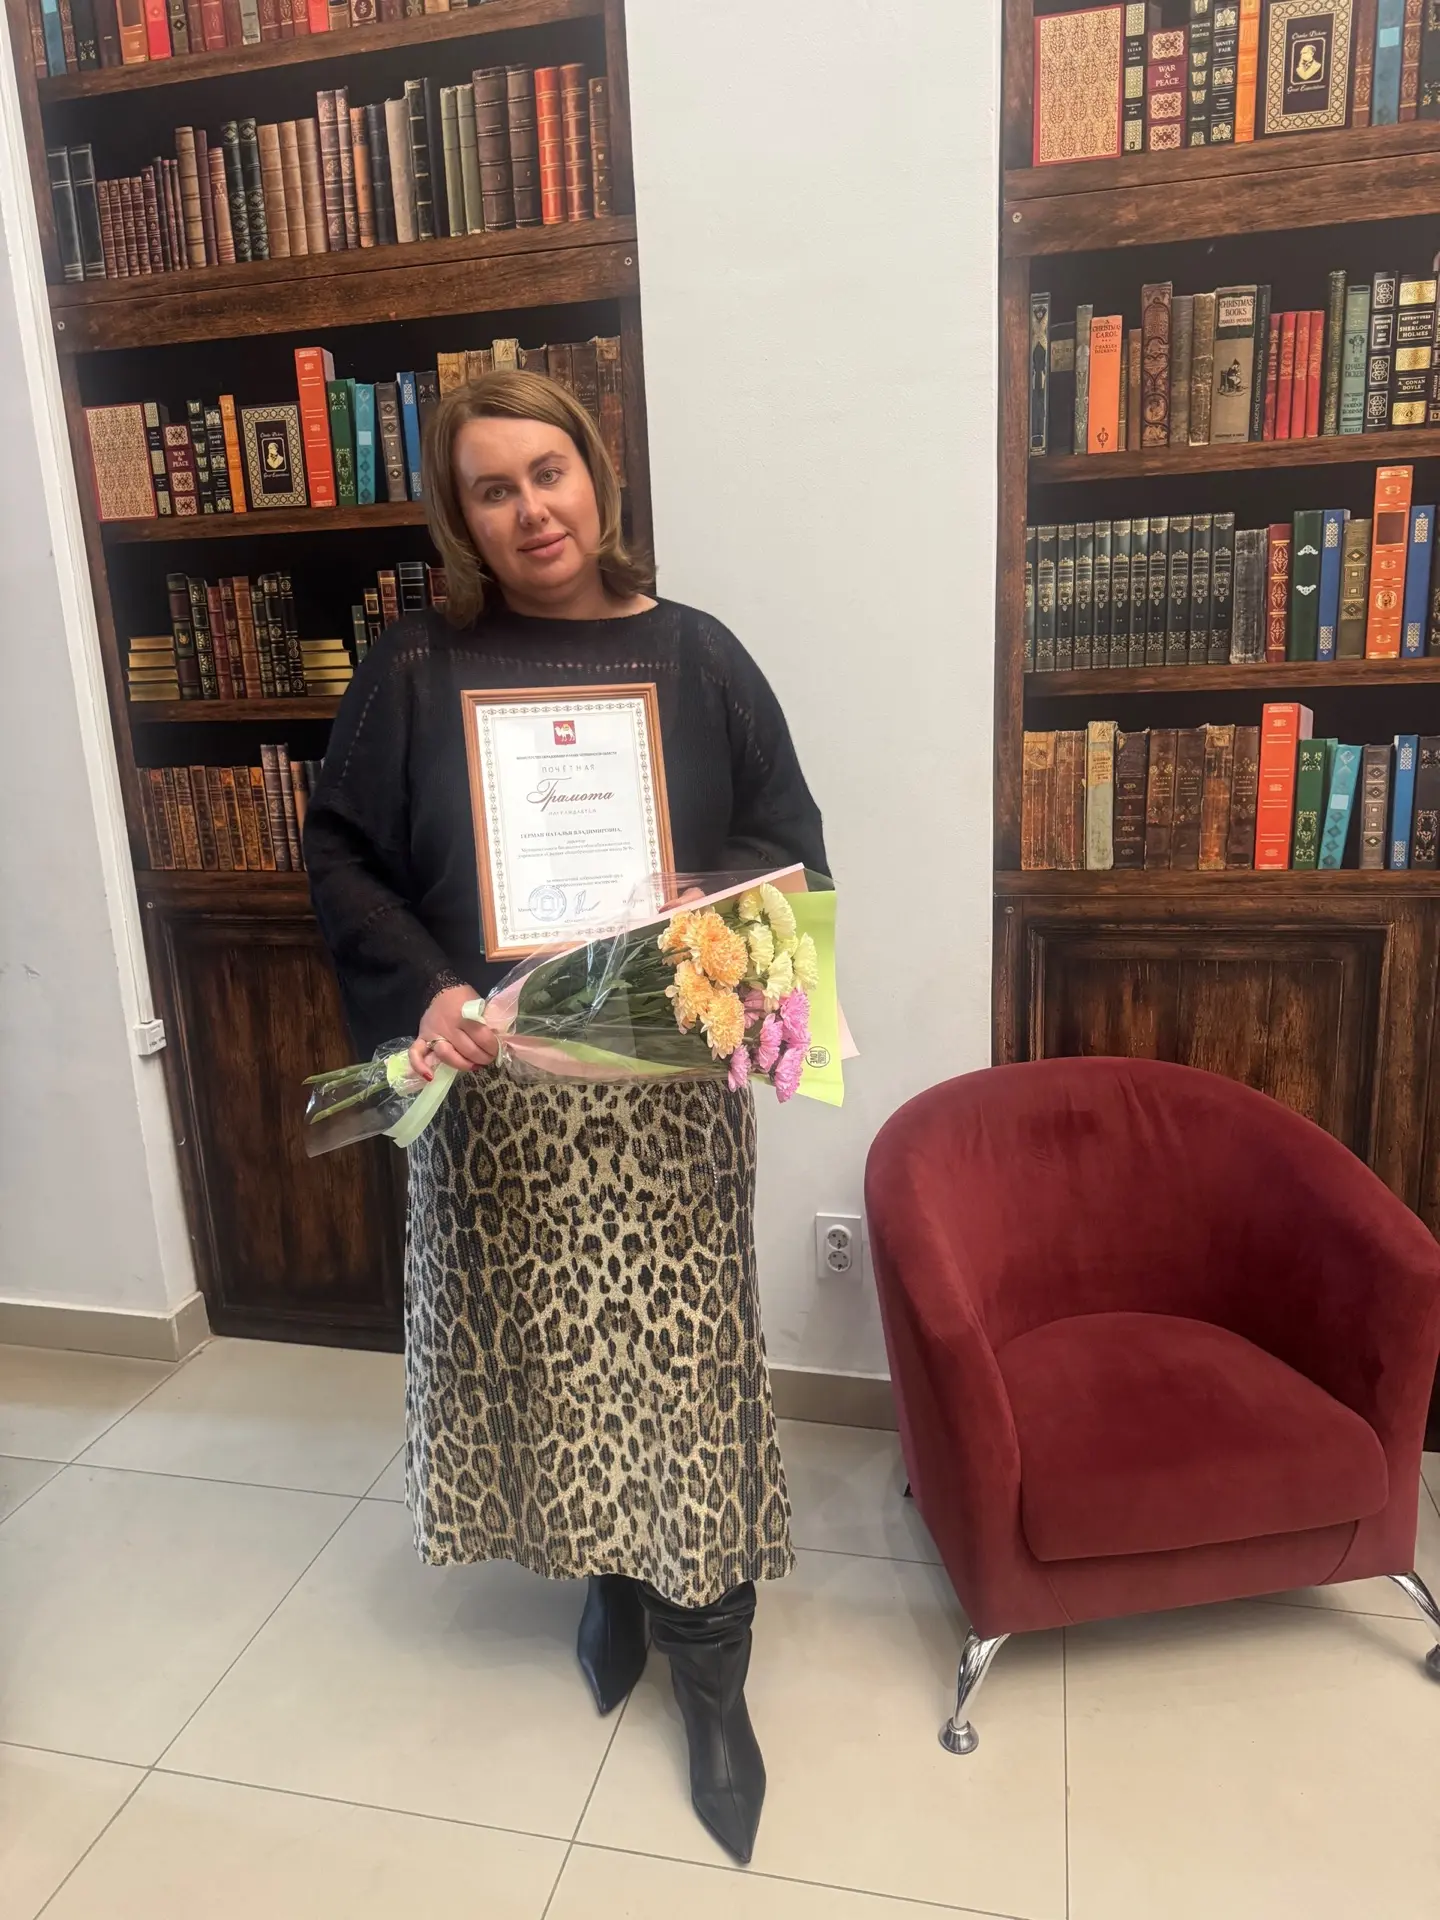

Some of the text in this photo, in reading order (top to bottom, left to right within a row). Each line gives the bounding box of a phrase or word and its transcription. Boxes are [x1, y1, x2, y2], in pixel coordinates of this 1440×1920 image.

[1158, 64, 1176, 73] WAR
[1155, 78, 1180, 87] PEACE
[1220, 299, 1254, 308] CHRISTMAS
[1225, 308, 1247, 316] BOOKS
[1095, 331, 1118, 339] CAROL
[526, 776, 615, 812] Грамота
